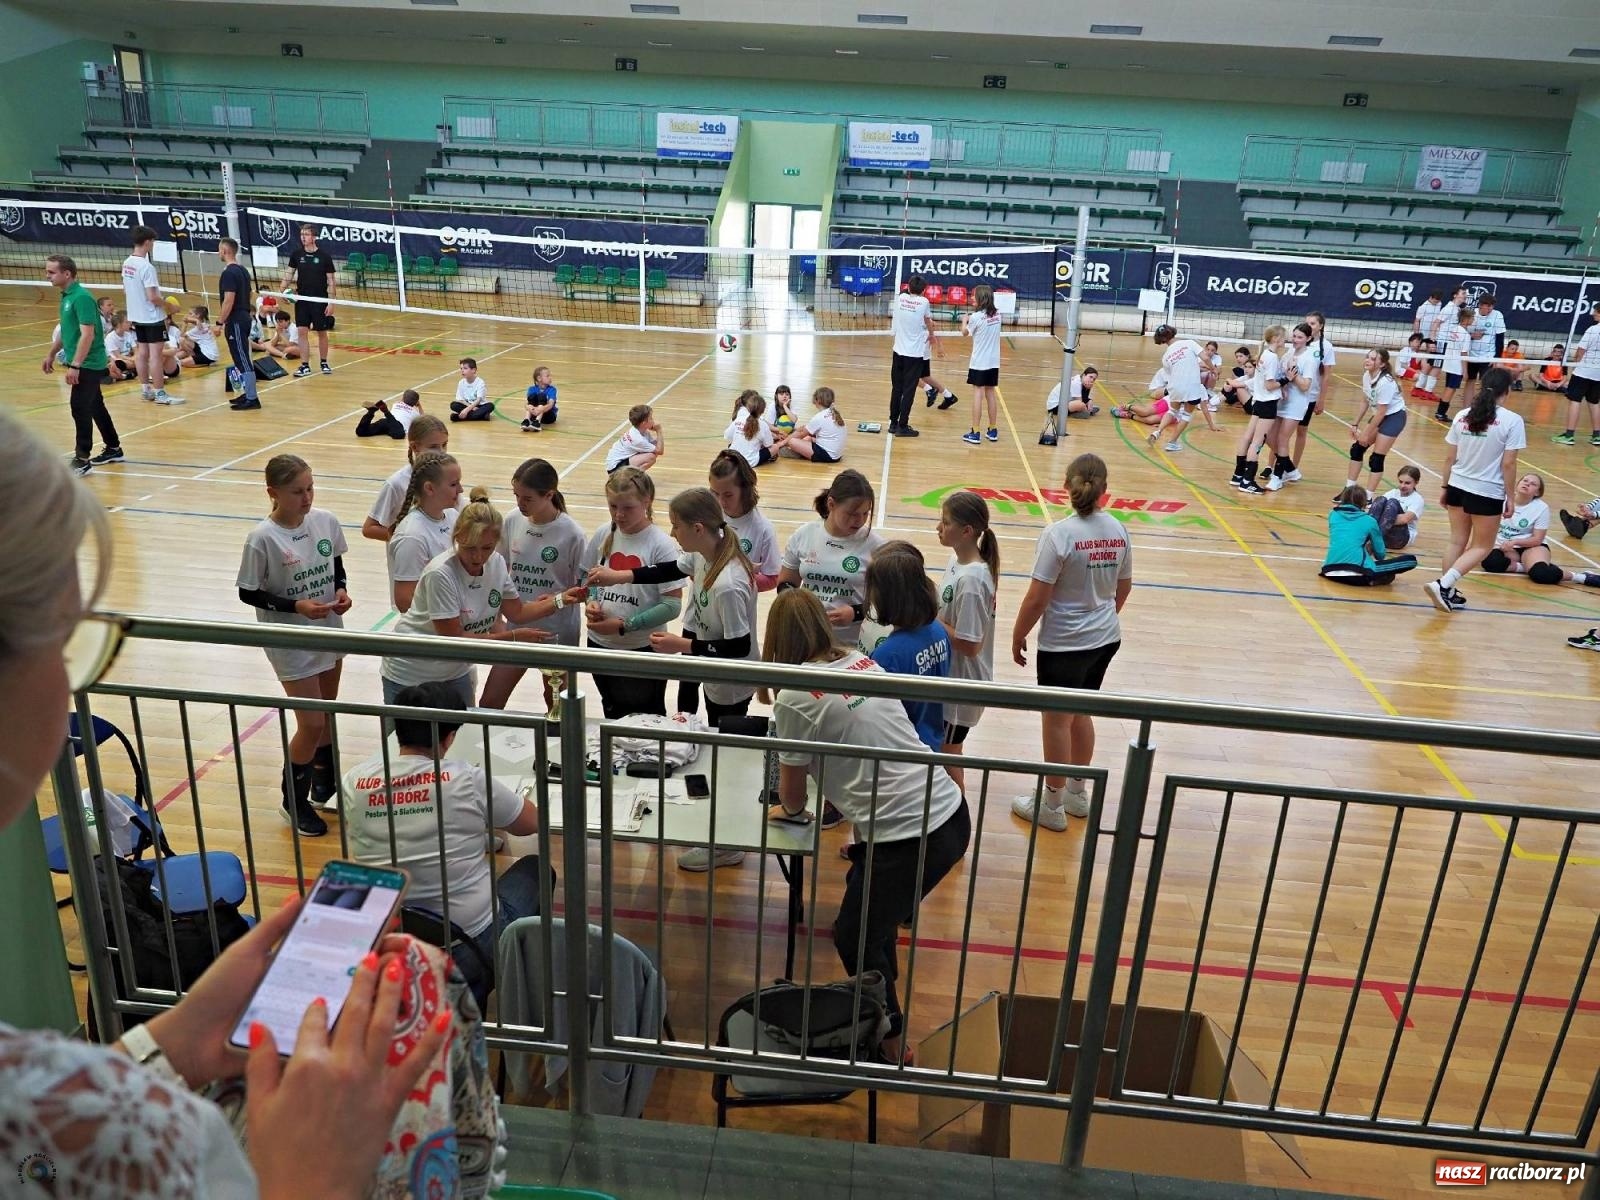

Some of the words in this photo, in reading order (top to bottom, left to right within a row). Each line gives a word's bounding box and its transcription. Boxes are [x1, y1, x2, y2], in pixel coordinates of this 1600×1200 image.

[1429, 148, 1480, 161] MIESZKO
[41, 209, 130, 230] RACIBÓRZ
[910, 258, 1010, 279] RACIBÓRZ
[1055, 261, 1111, 283] OiR
[1207, 275, 1311, 298] RACIBÓRZ
[1354, 278, 1414, 302] OSiR
[1375, 301, 1412, 310] RACIBÓRZ
[1075, 540, 1094, 551] KLUB
[294, 562, 329, 581] GRAMY
[511, 562, 547, 575] GRAMY
[286, 584, 309, 596] DLA
[309, 575, 335, 590] MAM
[522, 577, 555, 589] MAMY
[806, 572, 848, 585] GRAMY
[822, 585, 854, 597] MAMY
[915, 638, 947, 666] GRAMY
[355, 778, 382, 790] KLUB
